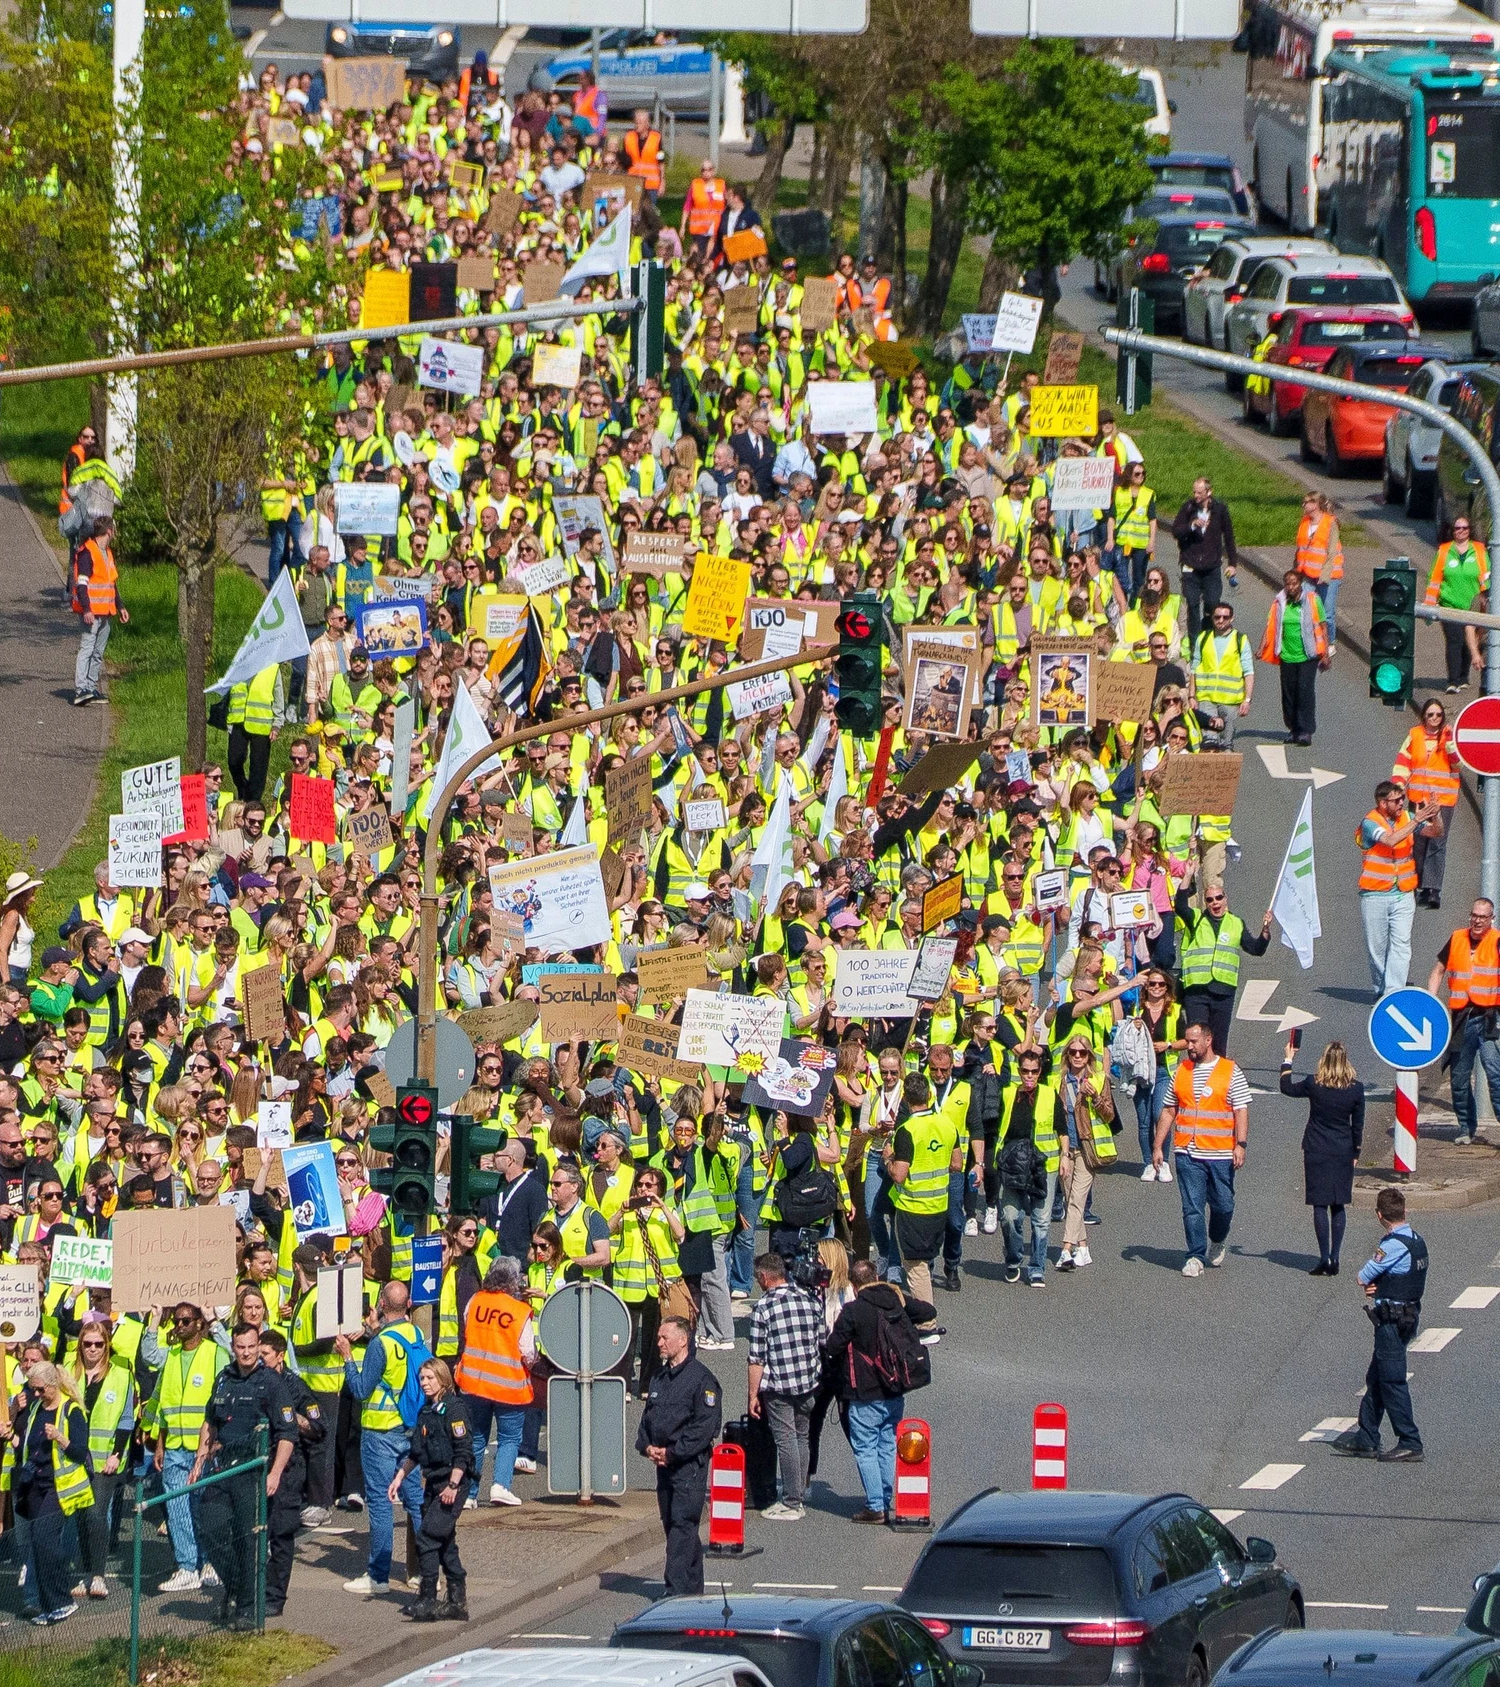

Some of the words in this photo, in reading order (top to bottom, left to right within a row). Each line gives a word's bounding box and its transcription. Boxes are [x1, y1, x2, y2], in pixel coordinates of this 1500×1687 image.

[1033, 386, 1064, 401] LOOK
[1067, 387, 1095, 401] WHAT
[1033, 402, 1054, 417] YOU
[1057, 402, 1091, 415] MADE
[633, 534, 679, 548] RESPEKT
[627, 554, 684, 566] AUSBEUTUNG
[706, 558, 738, 573] HIER
[393, 578, 420, 591] Ohne
[695, 575, 737, 595] NICHTS
[693, 594, 736, 612] FEIERN
[754, 609, 785, 628] 100
[742, 671, 781, 690] ERFOLG
[739, 684, 774, 703] NICHT
[132, 761, 174, 788] GUTE
[690, 812, 713, 821] LECK
[690, 821, 712, 829] EIER
[124, 831, 161, 842] SICHERN
[113, 850, 161, 864] ZUKUNFT
[115, 868, 159, 879] SICHERN
[494, 872, 514, 881] Noch
[515, 866, 533, 877] nicht
[534, 859, 567, 874] produktiv
[568, 851, 595, 865] genug?
[846, 959, 870, 972] 100
[874, 957, 910, 969] JAHRE
[860, 972, 899, 980] TRADITION
[541, 981, 617, 1007] Sozialplan
[715, 993, 731, 1001] NEW
[731, 994, 766, 1007] LUFTHANSA
[685, 1034, 706, 1045] OHNE
[742, 1057, 762, 1068] STOP
[50, 1261, 113, 1283] MITEINAND
[14, 1282, 35, 1294] CLH
[138, 1277, 233, 1300] MANAGEMENT
[2, 1308, 22, 1318] mehr
[475, 1306, 517, 1329] UFO
[976, 1630, 996, 1644] GG
[1004, 1631, 1014, 1645] C
[1016, 1632, 1043, 1646] 827
